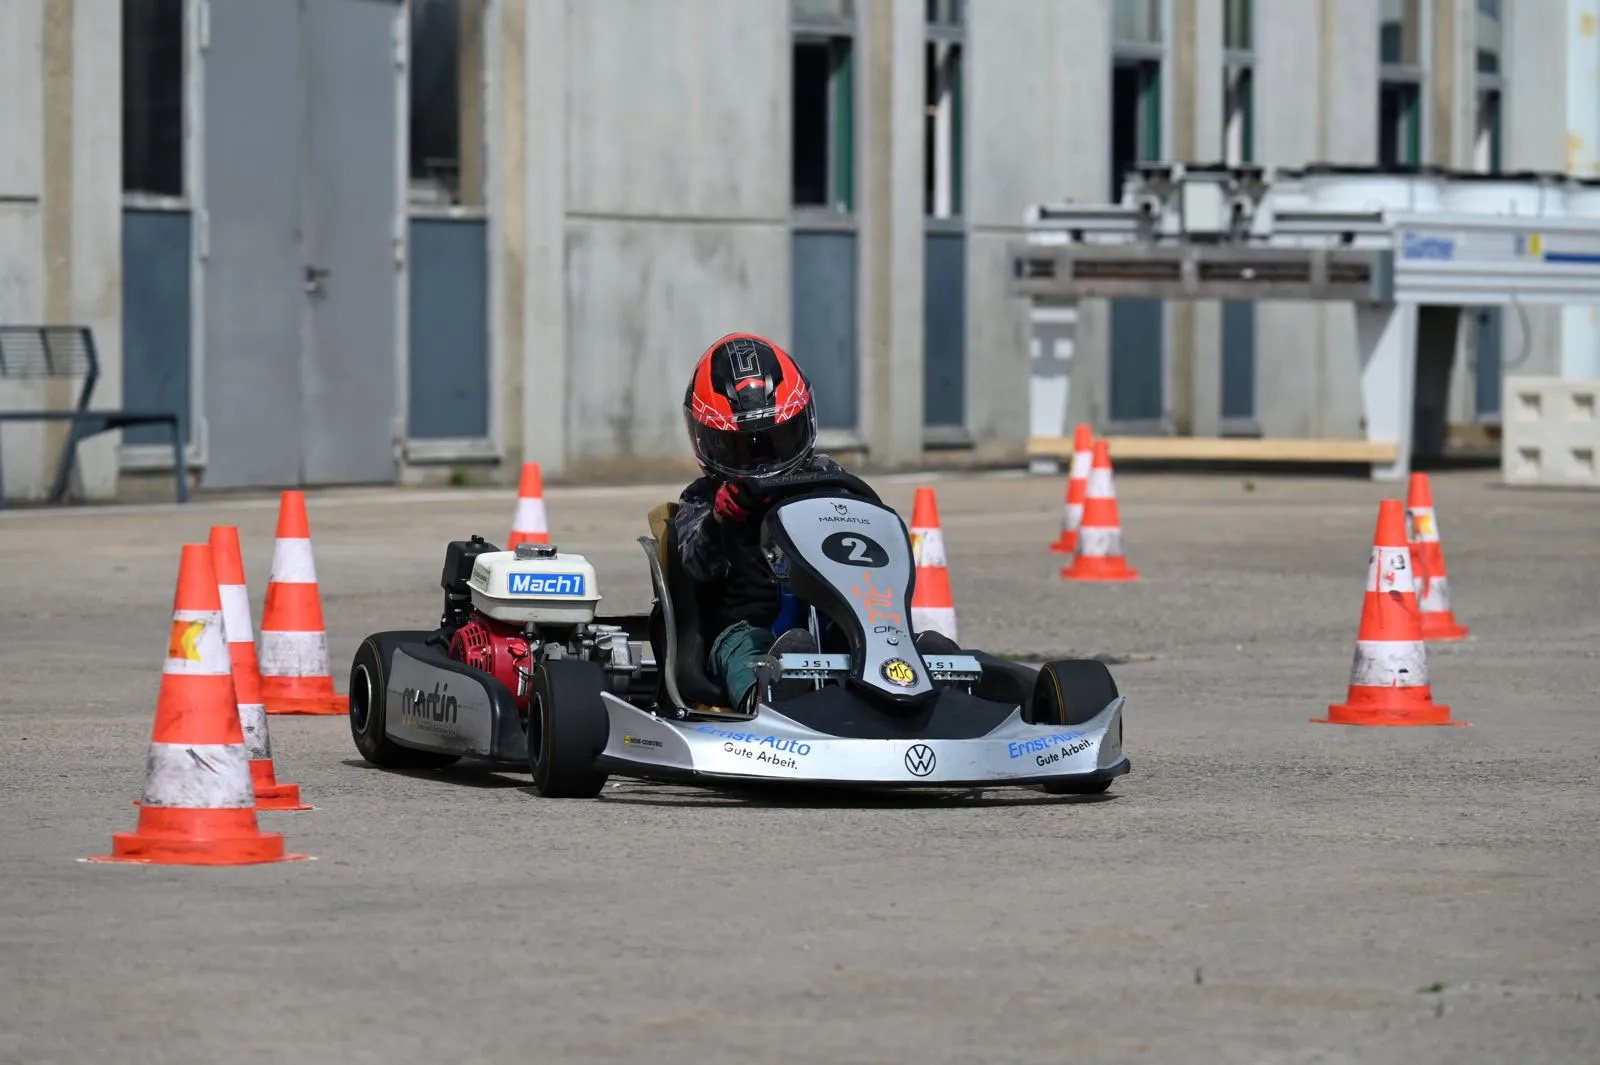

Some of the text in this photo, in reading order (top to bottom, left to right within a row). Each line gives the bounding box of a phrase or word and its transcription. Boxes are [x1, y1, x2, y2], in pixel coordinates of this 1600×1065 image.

[731, 406, 779, 423] LS2
[818, 516, 870, 525] MARKATUS
[841, 537, 873, 563] 2
[512, 574, 581, 593] Mach1
[802, 660, 831, 668] JS1
[889, 662, 912, 680] MSC
[402, 681, 458, 724] martin
[695, 726, 811, 756] Ernst-Auto
[1036, 739, 1094, 767] Gute Arbeit.
[724, 741, 798, 770] Gute Arbeit.
[905, 744, 936, 777] VW
